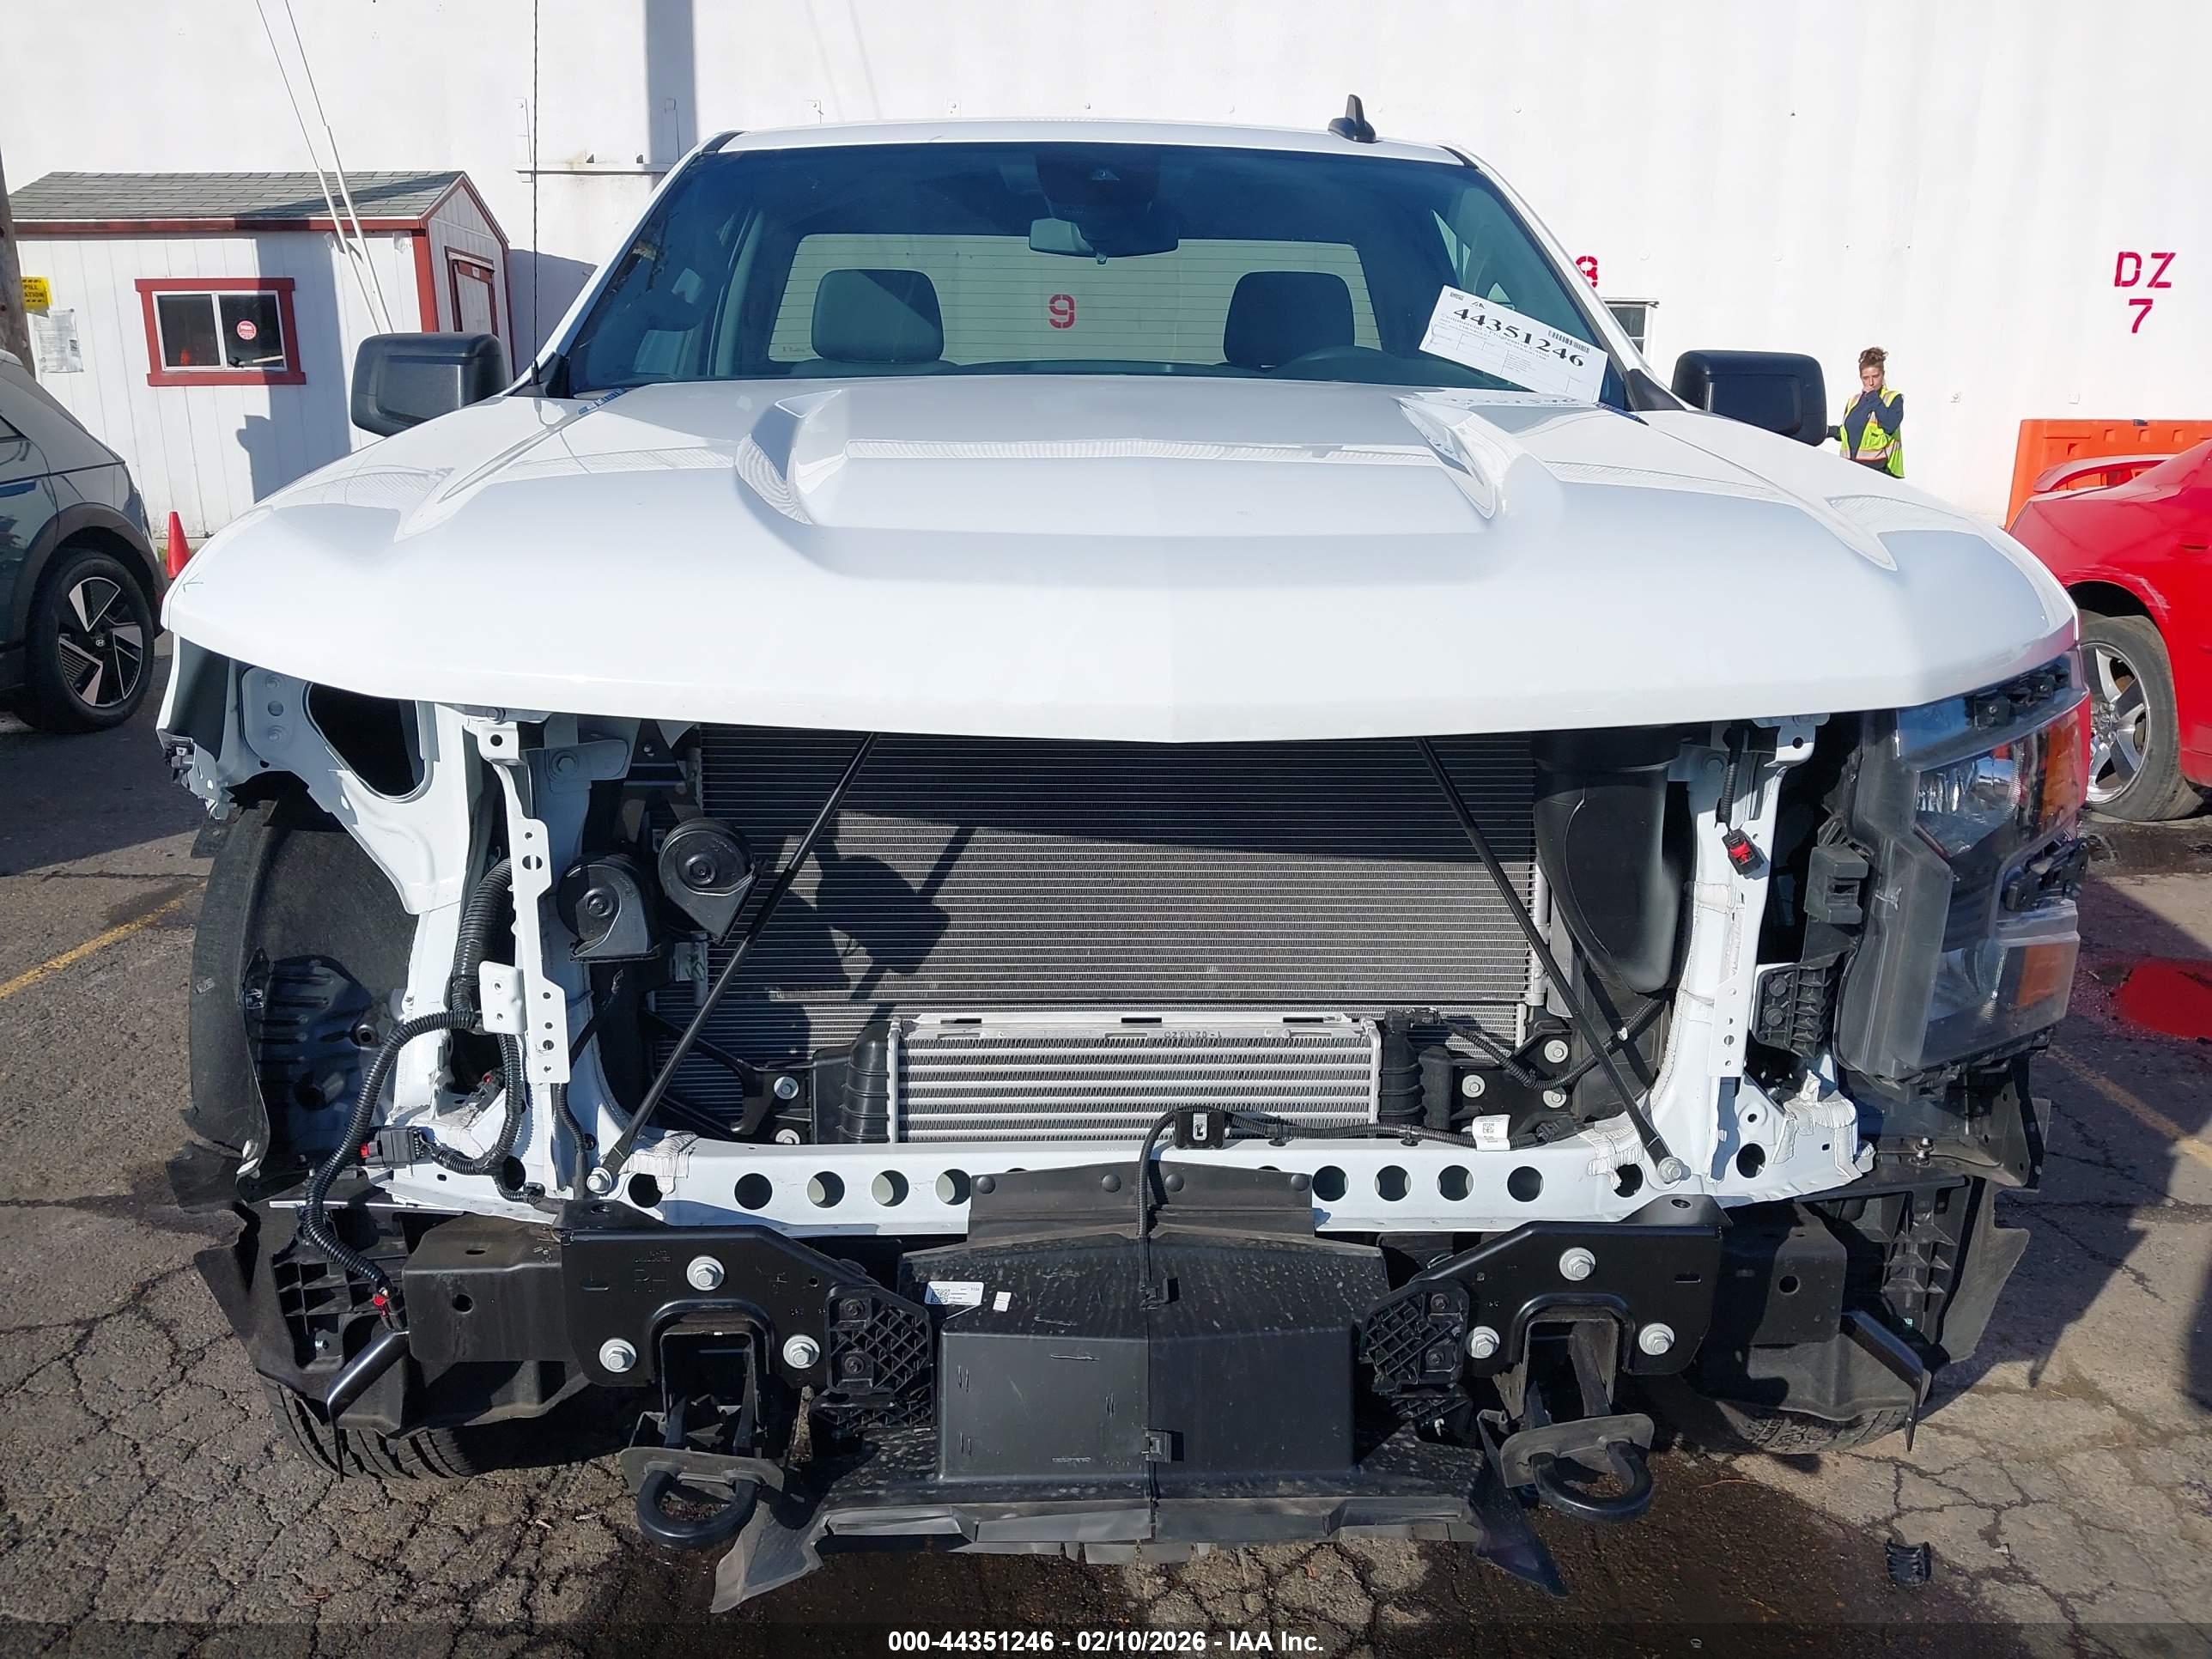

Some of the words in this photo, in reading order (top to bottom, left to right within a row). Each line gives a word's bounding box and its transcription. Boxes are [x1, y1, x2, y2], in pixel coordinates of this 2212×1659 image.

[2114, 252, 2176, 289] DZ
[1049, 295, 1075, 329] 9
[2129, 298, 2154, 333] 7
[1453, 307, 1585, 368] 44351246
